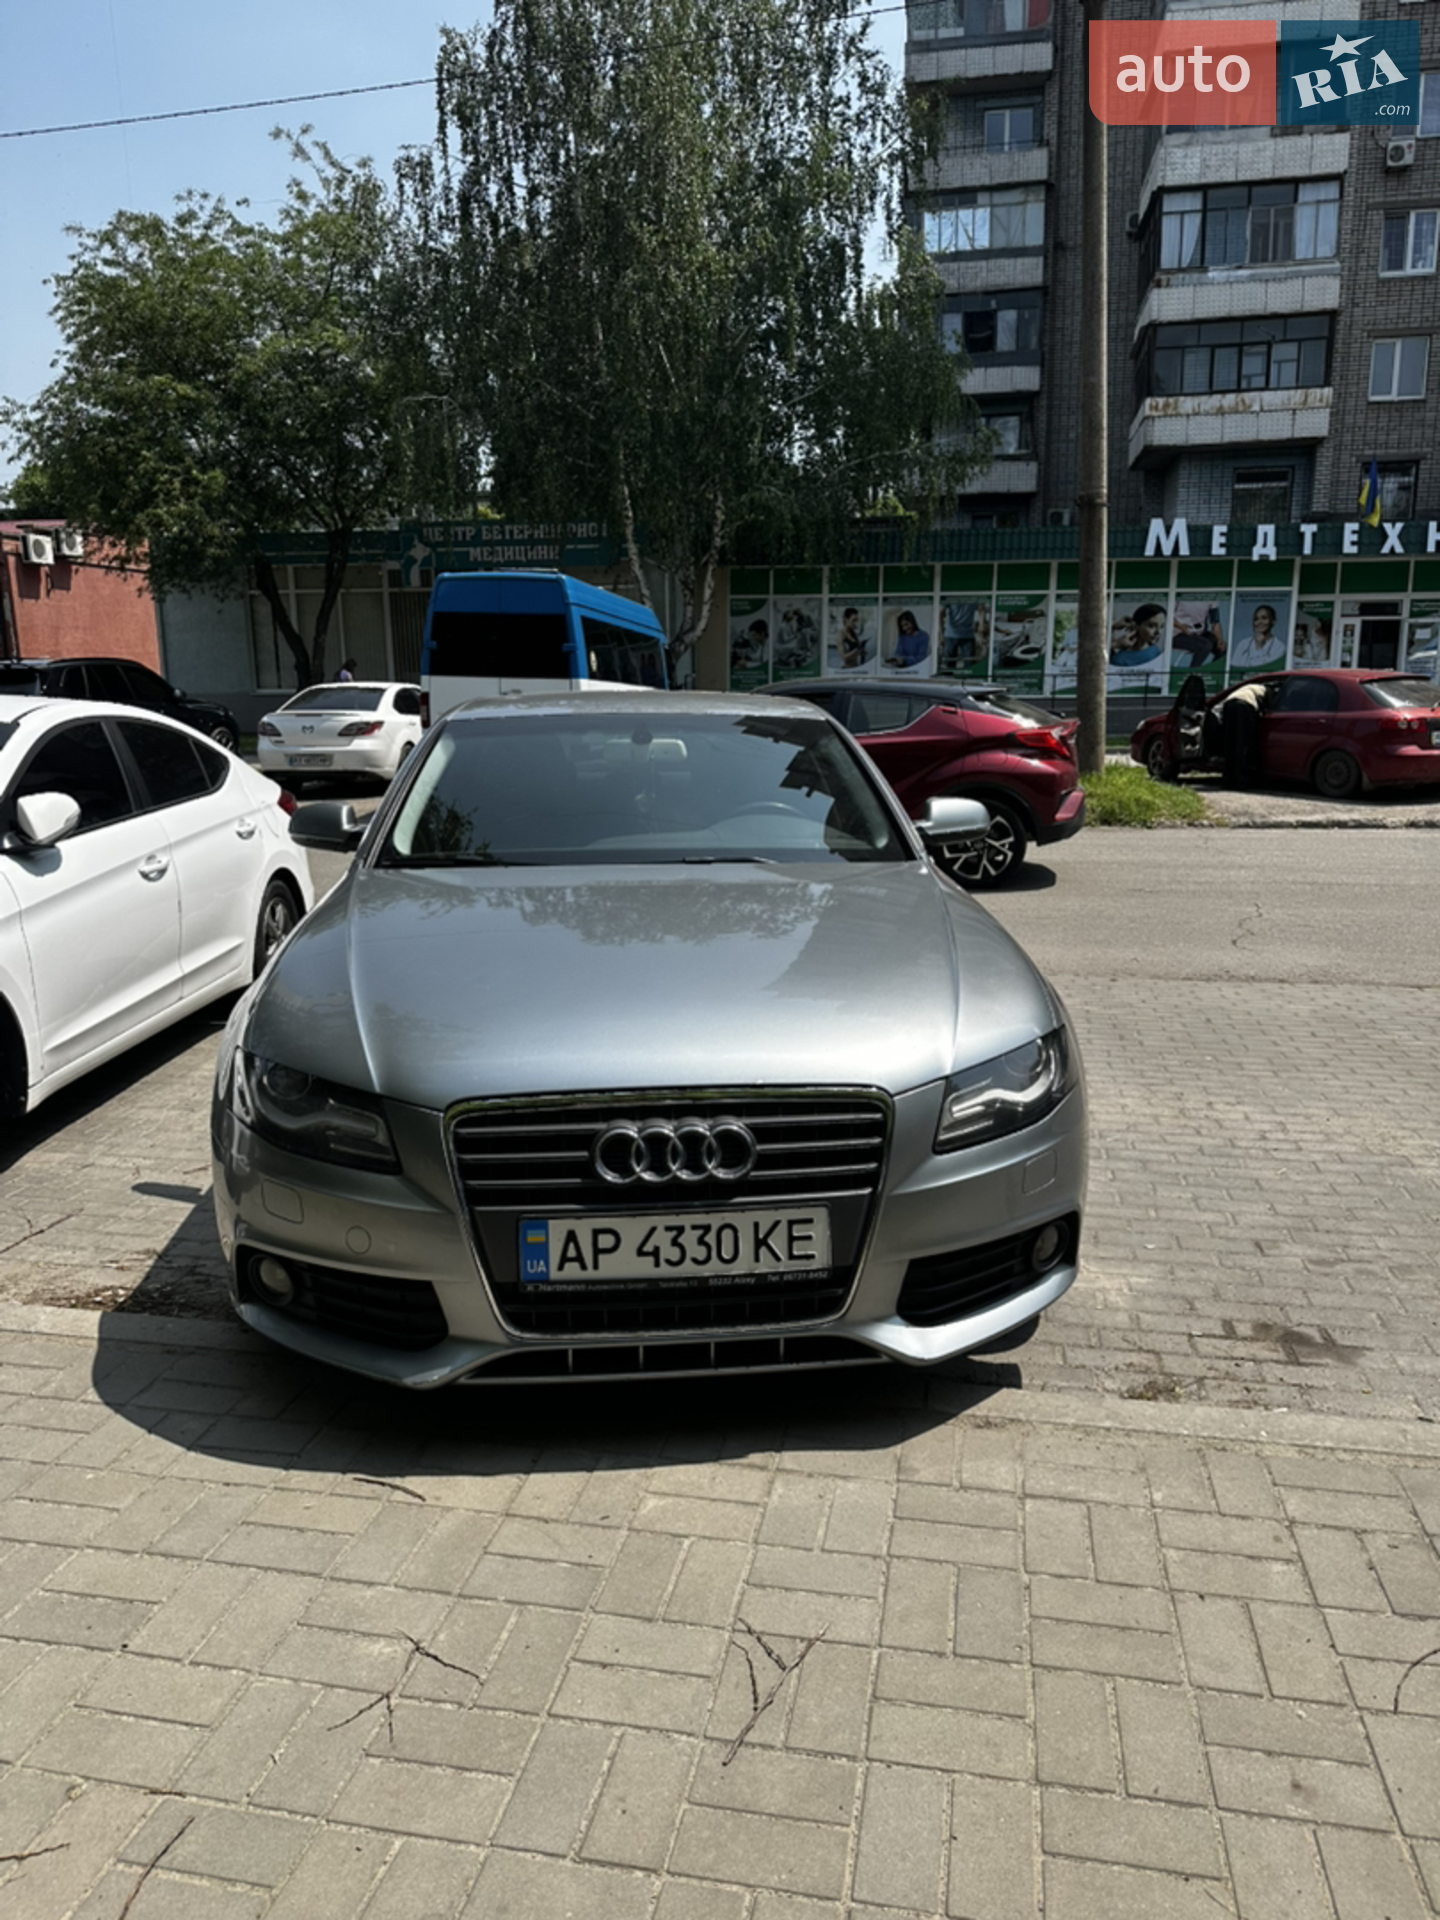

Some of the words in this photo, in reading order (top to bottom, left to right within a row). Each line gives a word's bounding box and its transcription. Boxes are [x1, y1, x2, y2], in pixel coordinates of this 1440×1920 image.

[556, 1228, 622, 1272] AP
[636, 1223, 741, 1269] 4330
[753, 1217, 817, 1263] KE
[526, 1259, 547, 1274] UA
